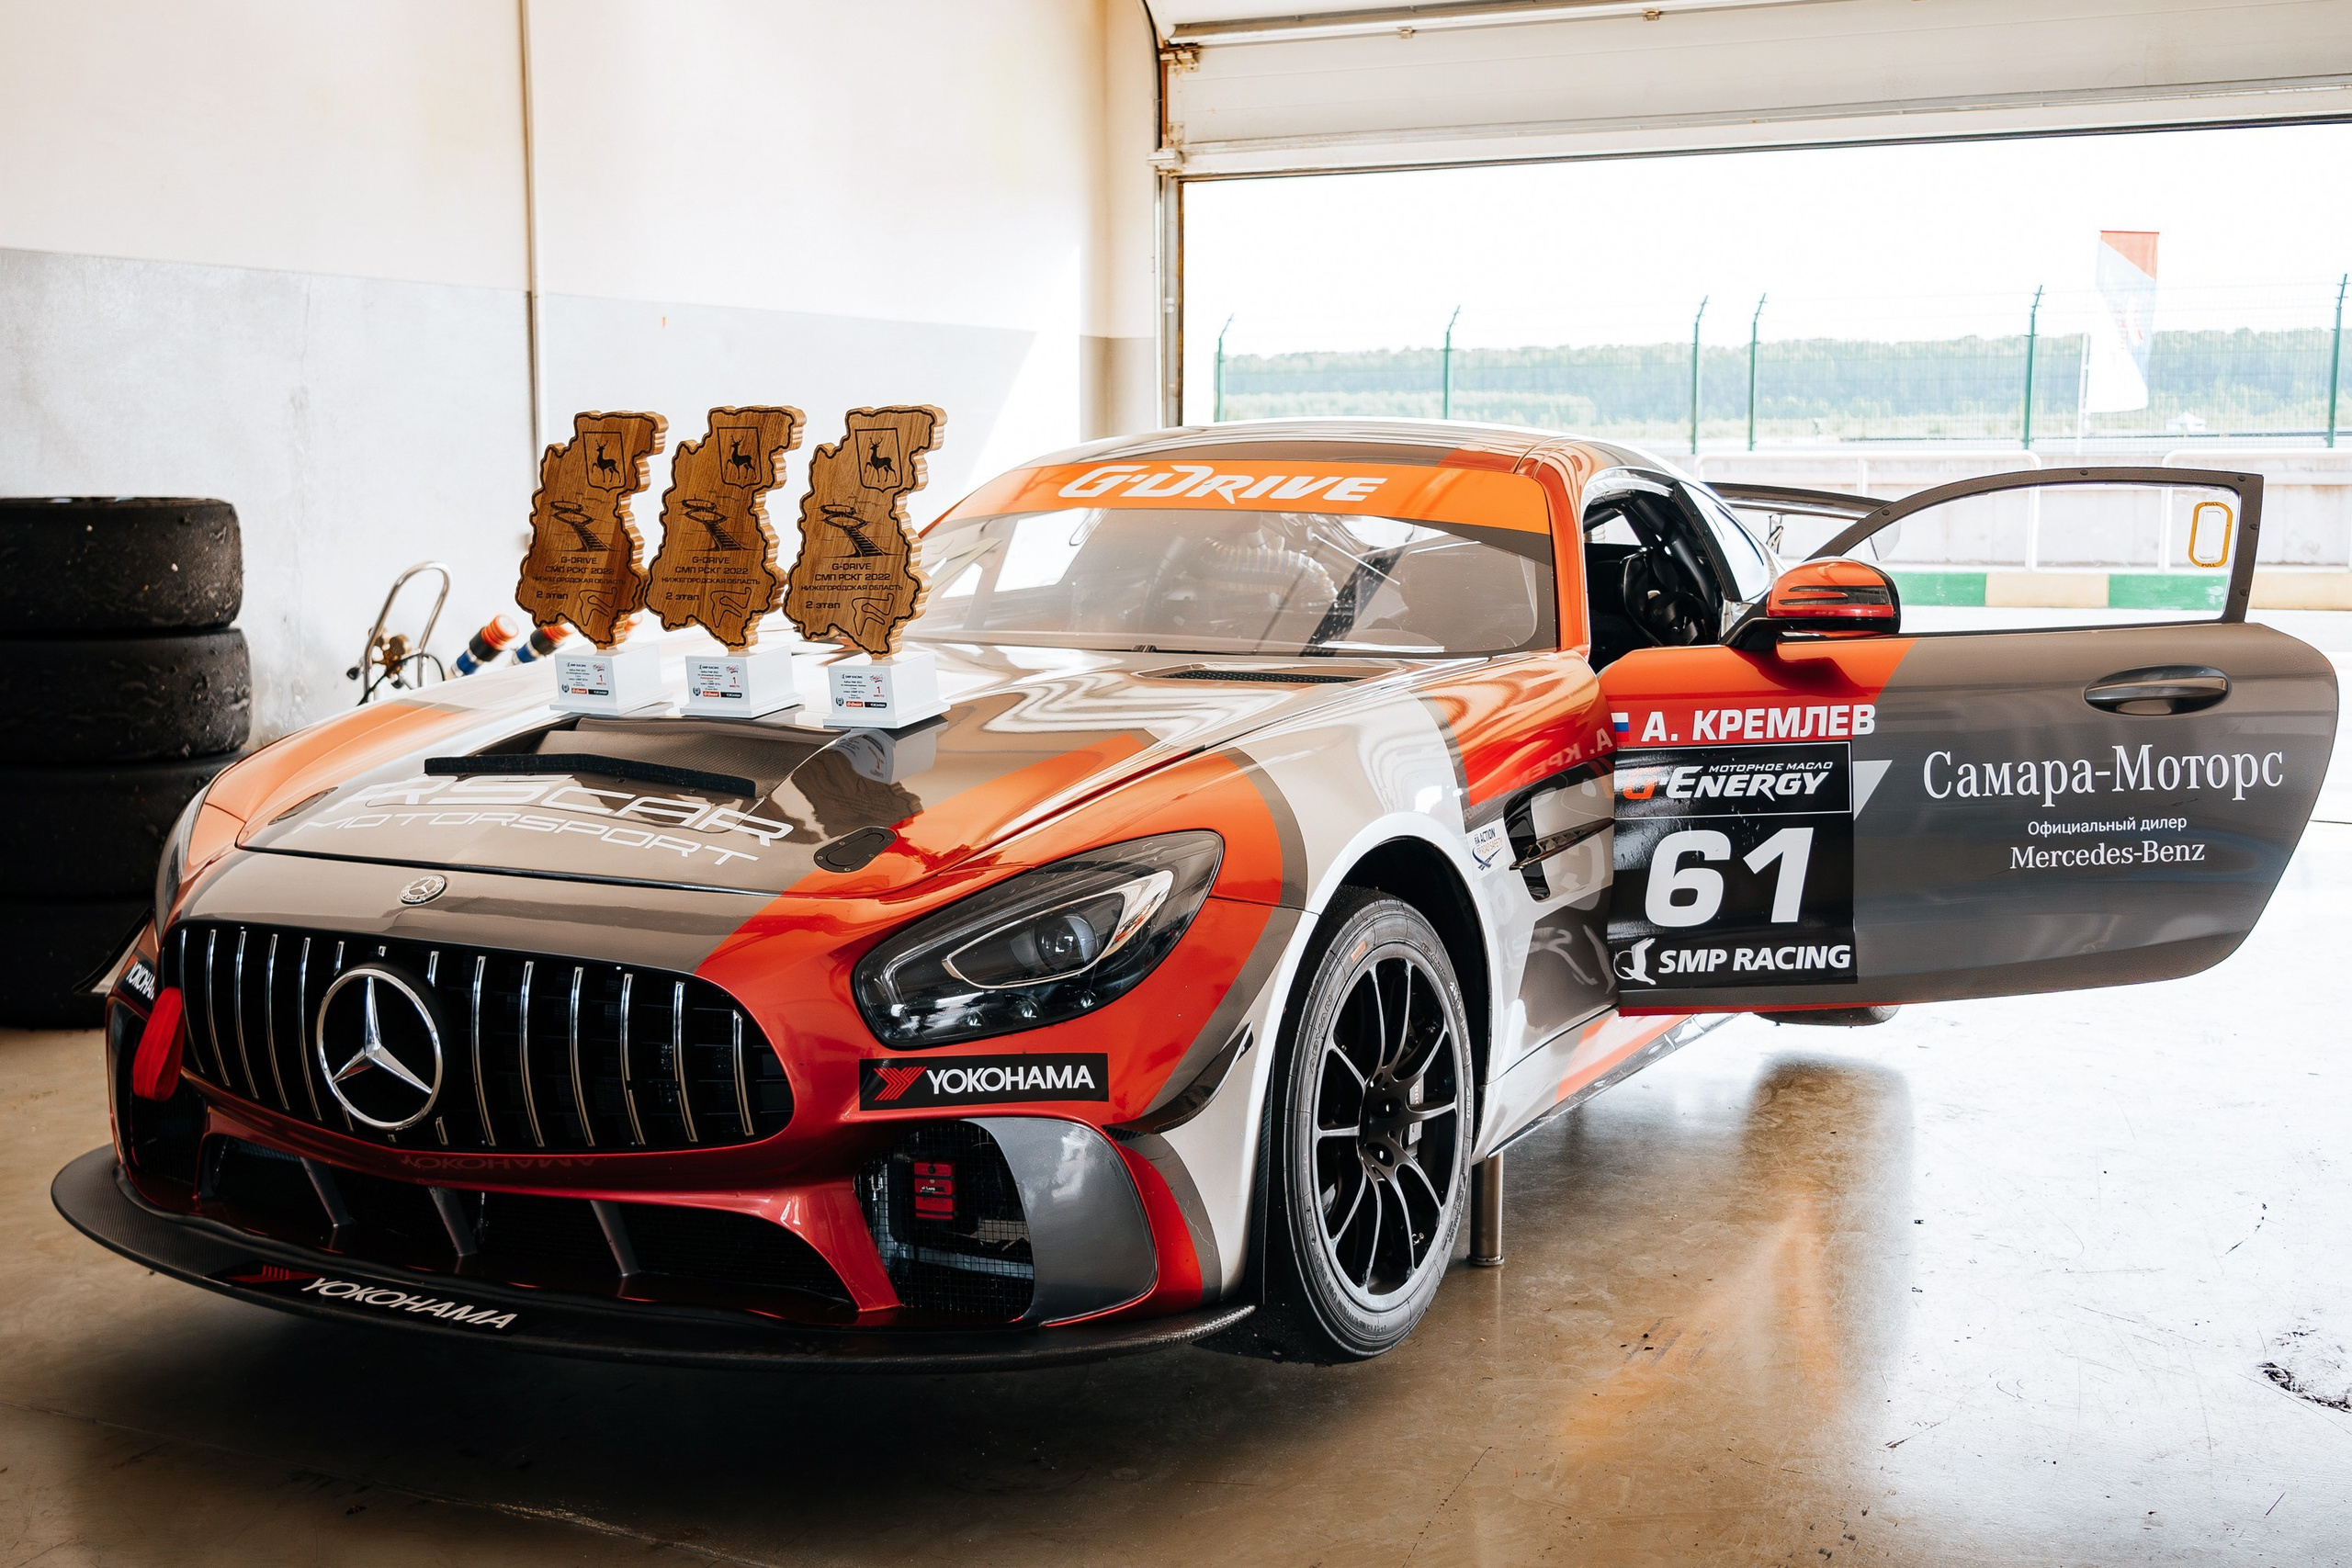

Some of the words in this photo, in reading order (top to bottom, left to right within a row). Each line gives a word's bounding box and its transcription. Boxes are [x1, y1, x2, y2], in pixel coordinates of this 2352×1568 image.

[675, 566, 696, 574] СМП
[697, 566, 721, 574] РСКГ
[723, 567, 749, 575] 2022
[692, 556, 730, 564] G-DRIVE
[814, 573, 836, 581] СМП
[838, 573, 863, 581] РСКГ
[865, 573, 891, 581] 2022
[665, 592, 673, 600] 2
[675, 592, 700, 601] этап
[805, 601, 813, 609] 2
[1641, 711, 1679, 742] А.
[1691, 704, 1876, 741] КРЕМЛЕВ
[1709, 762, 1785, 773] МОТОРНОЕ
[1786, 761, 1834, 771] МАСЛО
[1923, 744, 2284, 807] Самара-Моторс
[293, 811, 760, 865] MOTORSPORT
[2028, 816, 2136, 838] Официальный
[2140, 816, 2188, 833] дилер
[2009, 840, 2206, 869] Mercedes-Benz
[1645, 827, 1815, 928] 61
[1657, 948, 1728, 974] SMP
[1732, 945, 1851, 971] RACING
[926, 1065, 1095, 1095] YOKOHAMA
[300, 1276, 518, 1329] YOKOHAMA
